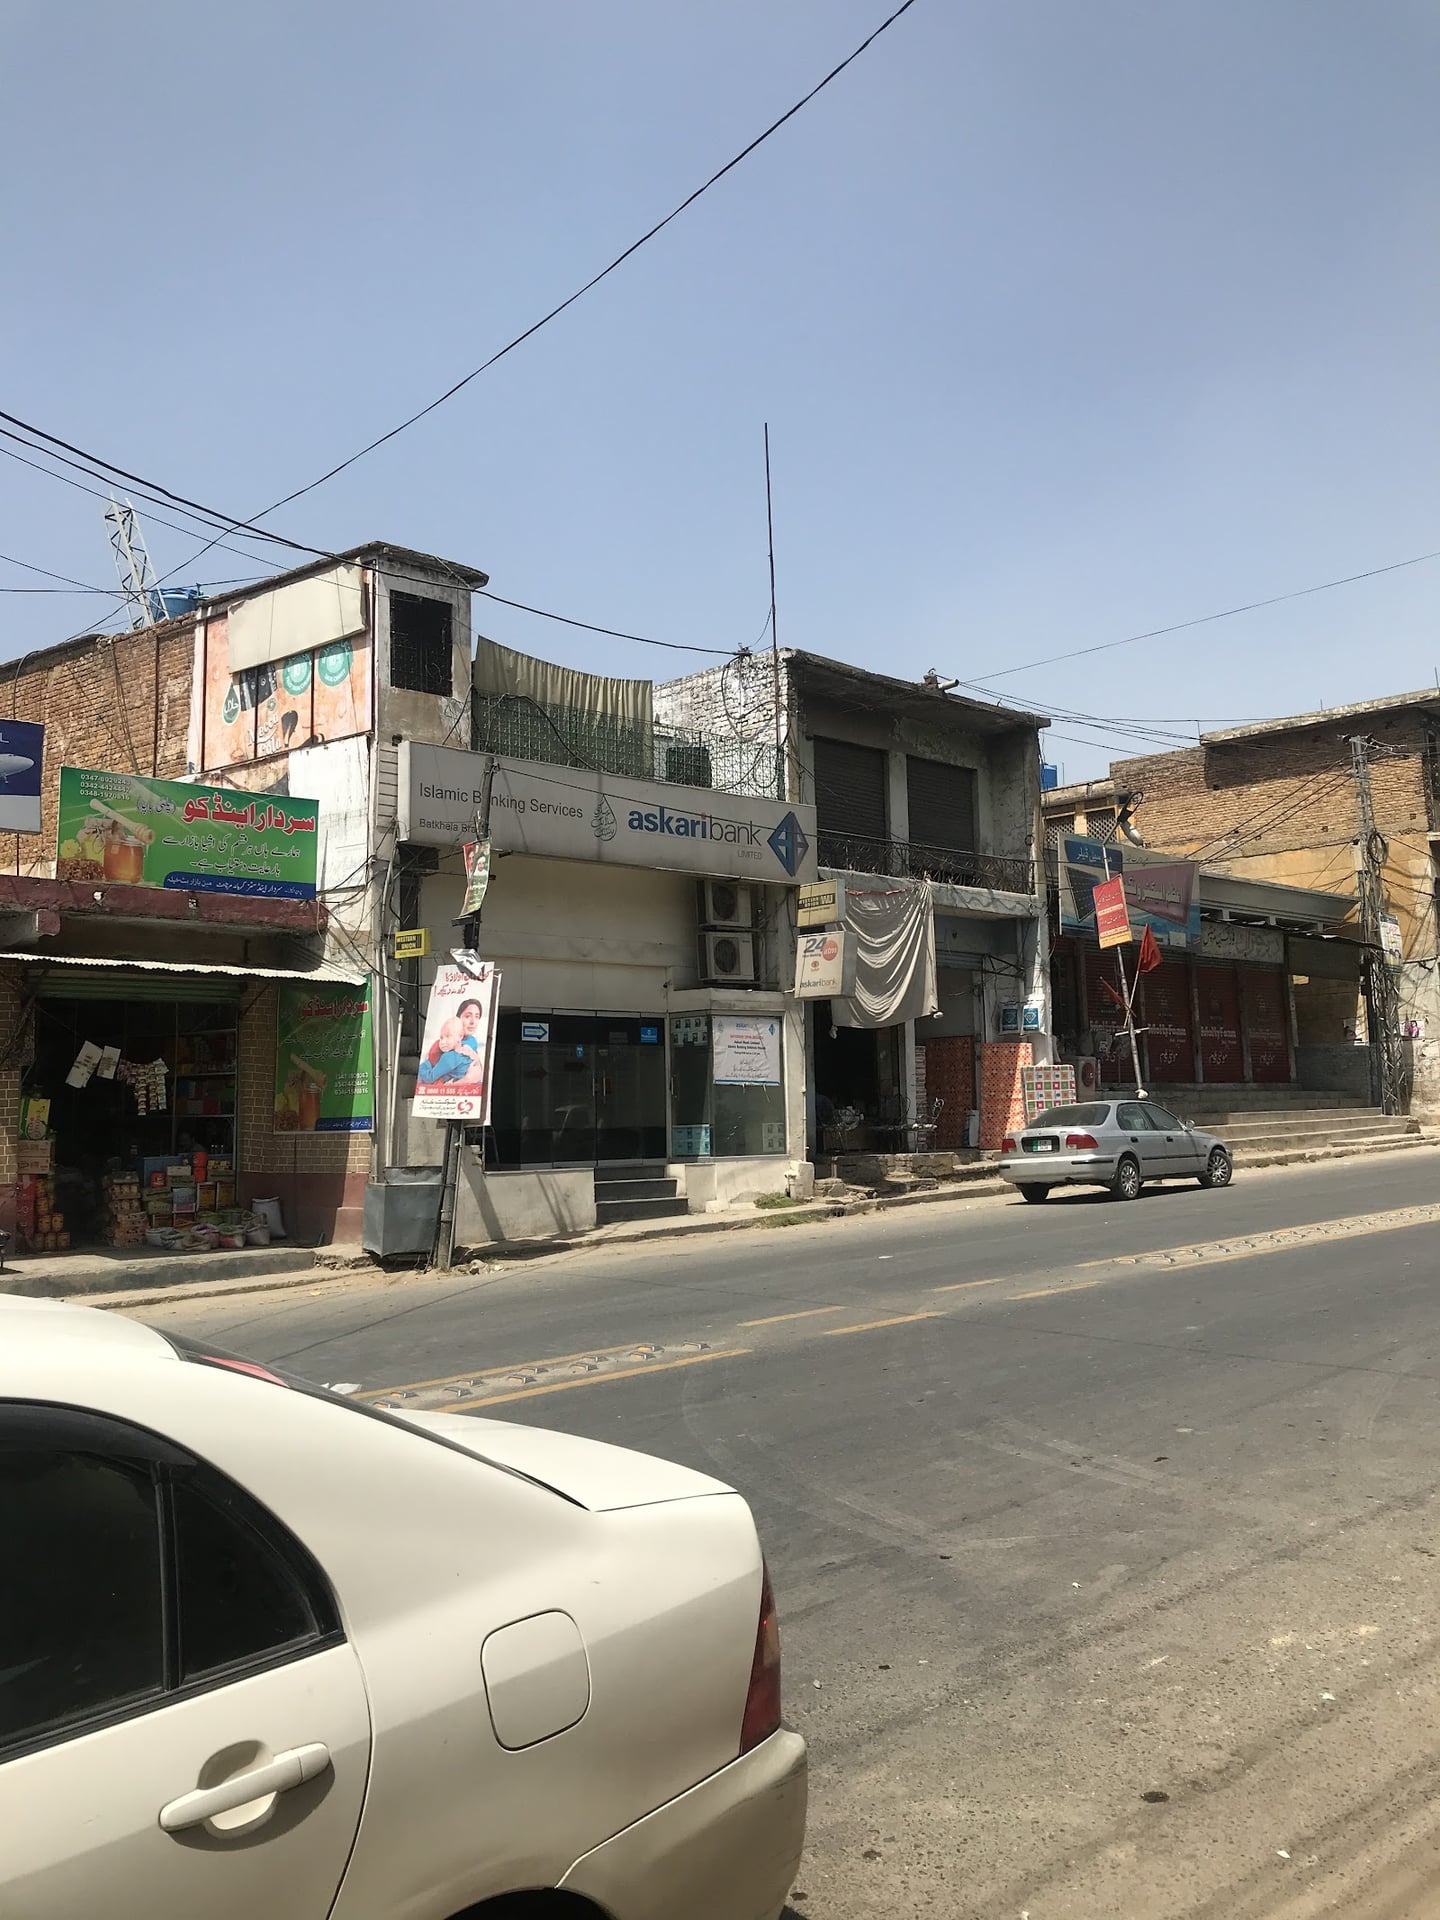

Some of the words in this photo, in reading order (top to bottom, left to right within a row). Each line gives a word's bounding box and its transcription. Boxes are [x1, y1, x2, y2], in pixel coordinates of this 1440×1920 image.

[419, 783, 469, 803] Islamic
[472, 790, 525, 813] Bnking
[530, 798, 584, 818] Services
[181, 797, 210, 824] کو
[211, 792, 256, 830] اینڈ
[254, 803, 316, 835] سردار
[419, 818, 459, 832] Batkhela
[217, 833, 232, 853] کی
[231, 833, 248, 857] قسم
[241, 845, 253, 856] ہر
[254, 842, 269, 858] ہاں
[271, 845, 301, 858] ہمارے
[737, 850, 763, 861] LIMITED
[396, 935, 417, 943] WESTERN
[401, 942, 417, 950] UNION
[804, 937, 827, 953] 24
